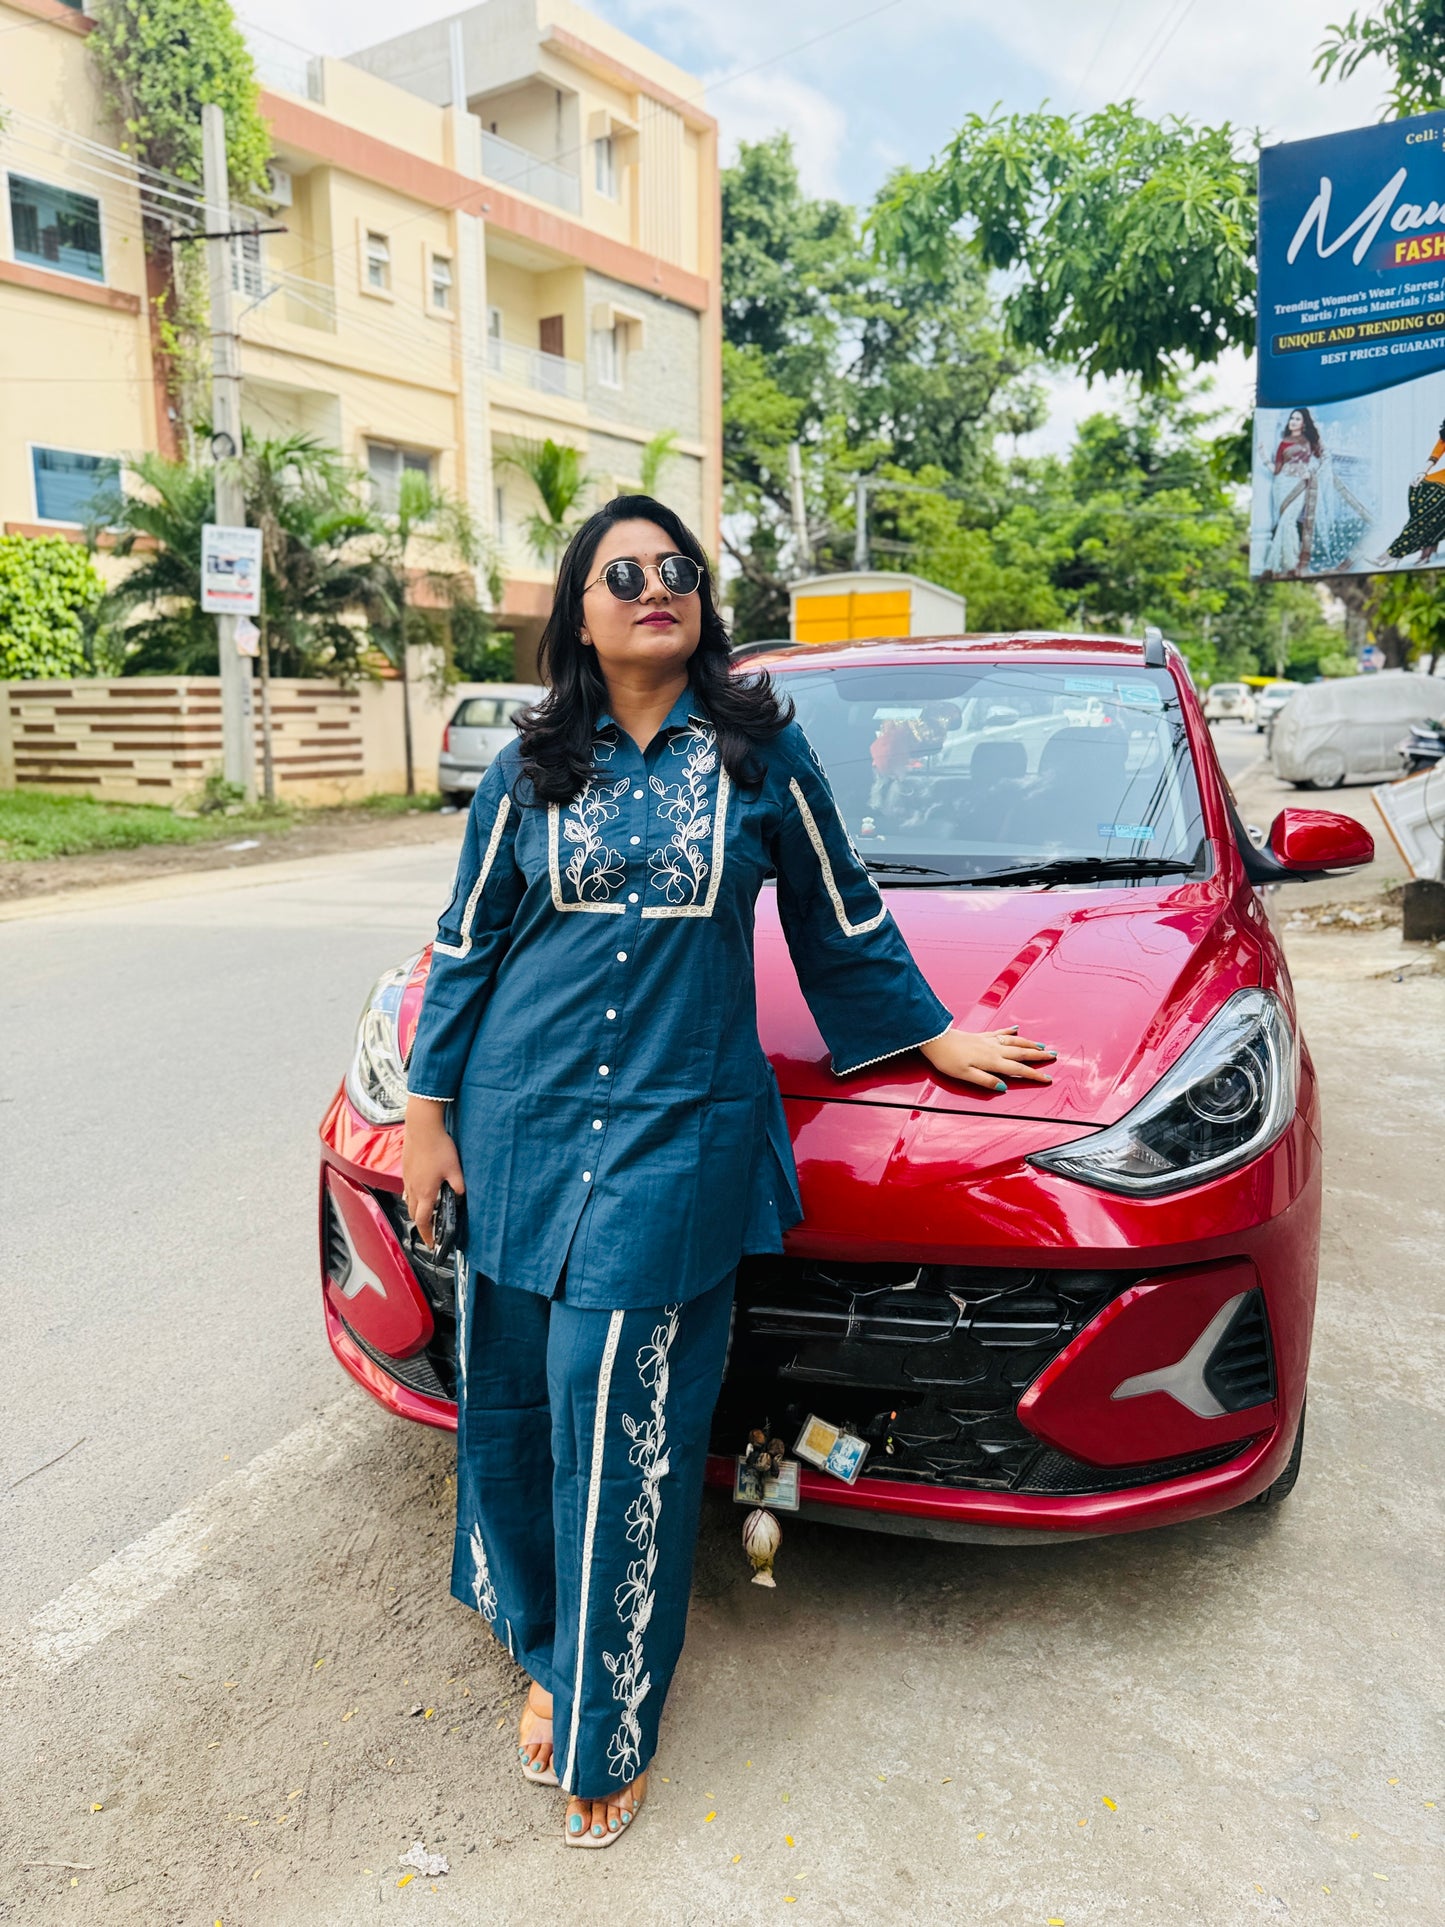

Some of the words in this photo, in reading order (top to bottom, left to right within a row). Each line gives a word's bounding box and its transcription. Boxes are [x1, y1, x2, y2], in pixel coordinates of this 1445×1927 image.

[1405, 128, 1438, 145] Cell:
[1395, 236, 1445, 263] FASH
[1274, 298, 1320, 315] Trending
[1321, 291, 1367, 307] Women's
[1368, 286, 1396, 299] Wear
[1404, 280, 1439, 294] Sarees
[1301, 309, 1332, 323] Kurtis
[1339, 304, 1368, 317] Dress
[1370, 296, 1420, 312] Materials
[1427, 290, 1445, 303] Sal
[1278, 331, 1326, 349] UNIQUE
[1327, 326, 1355, 342] AND
[1358, 315, 1424, 337] TRENDING
[1426, 312, 1445, 326] CO
[1320, 351, 1348, 365] BEST
[1349, 346, 1389, 361] PRICES
[1390, 336, 1445, 355] GUARANT
